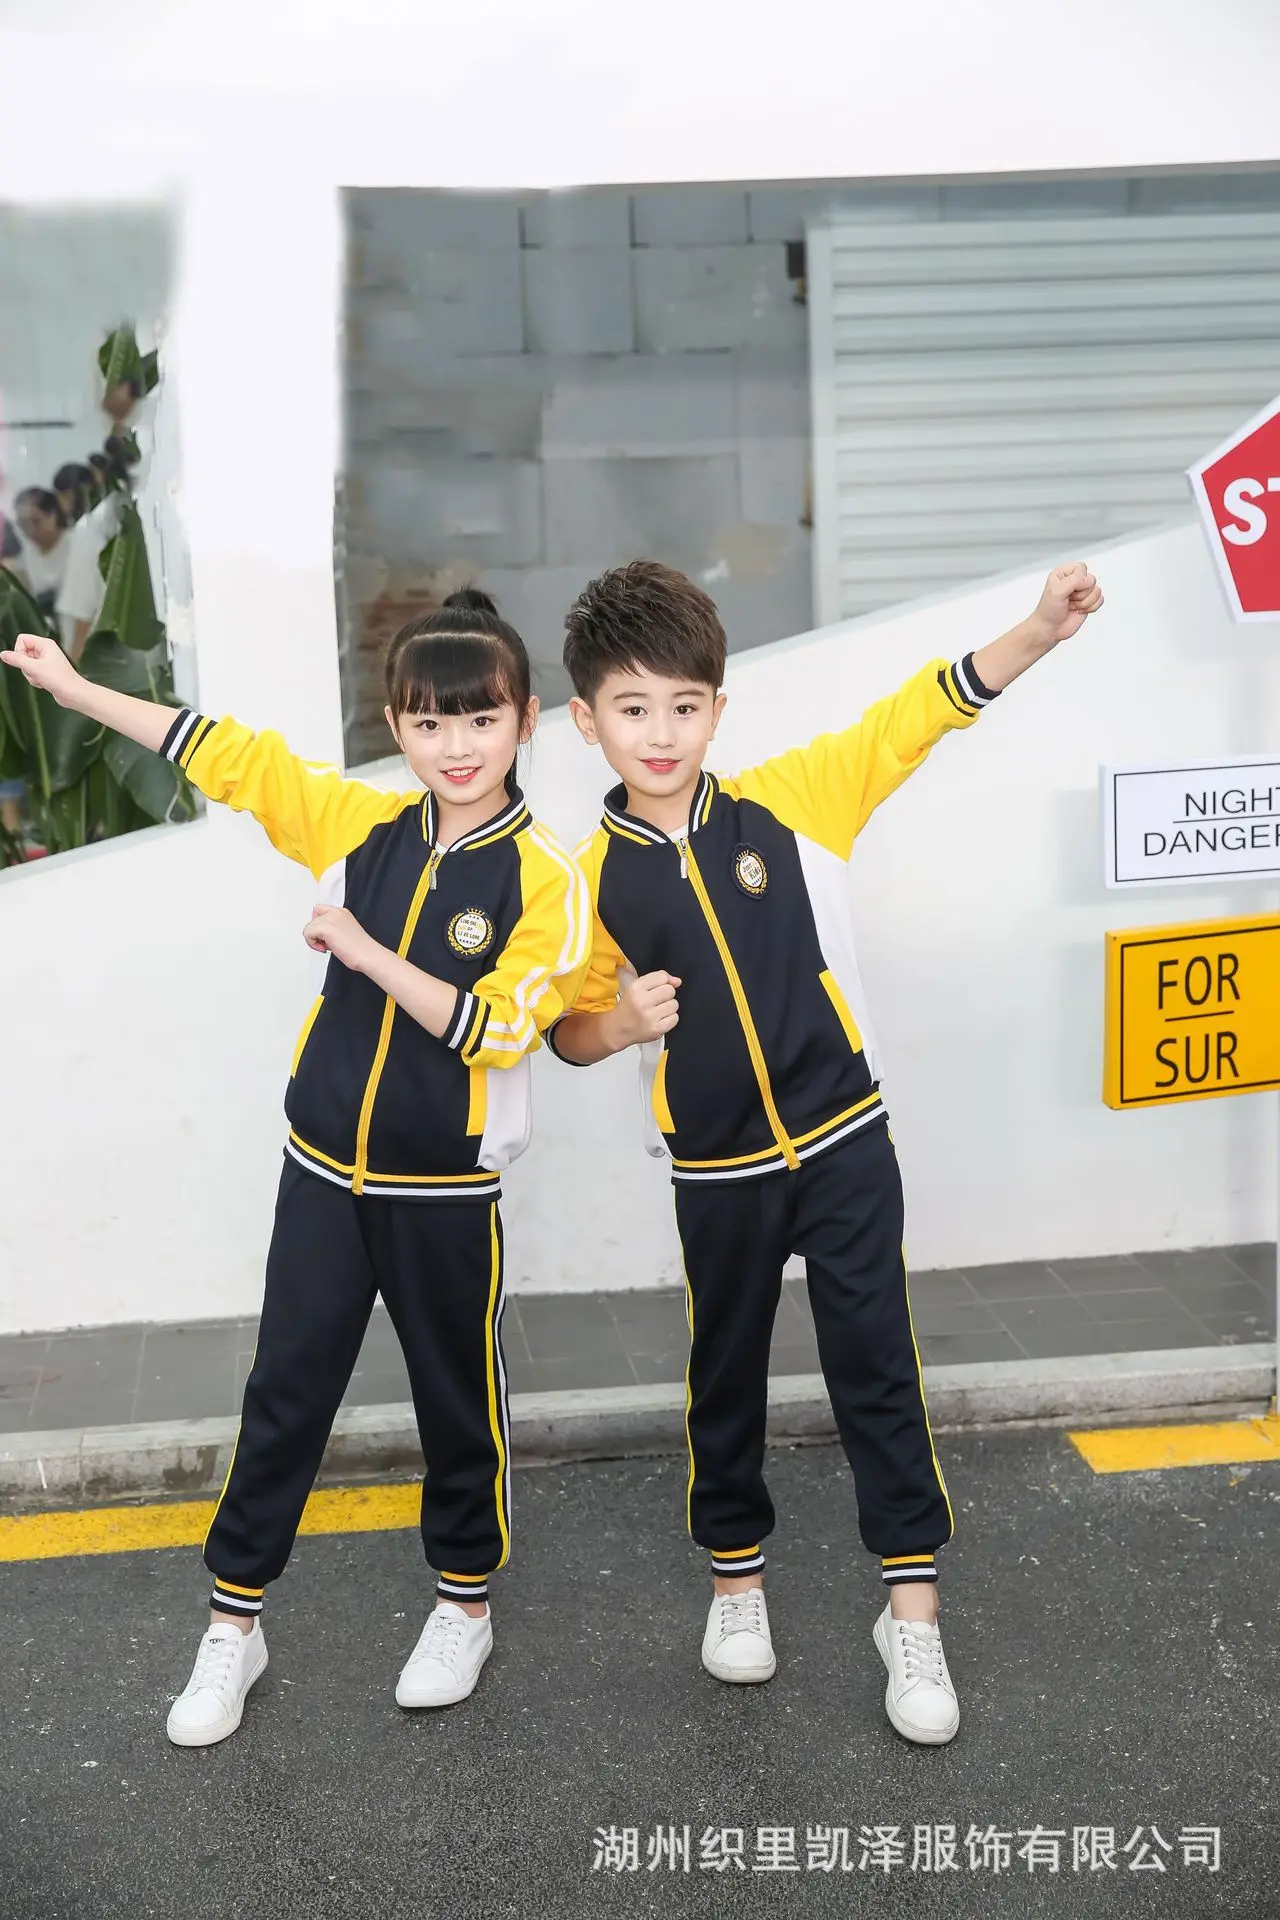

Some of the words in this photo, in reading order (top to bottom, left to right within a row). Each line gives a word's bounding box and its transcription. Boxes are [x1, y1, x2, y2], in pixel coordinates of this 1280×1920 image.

[1221, 477, 1280, 546] S
[1185, 786, 1280, 817] NIGH
[1157, 952, 1241, 1011] FOR
[1154, 1031, 1240, 1088] SUR
